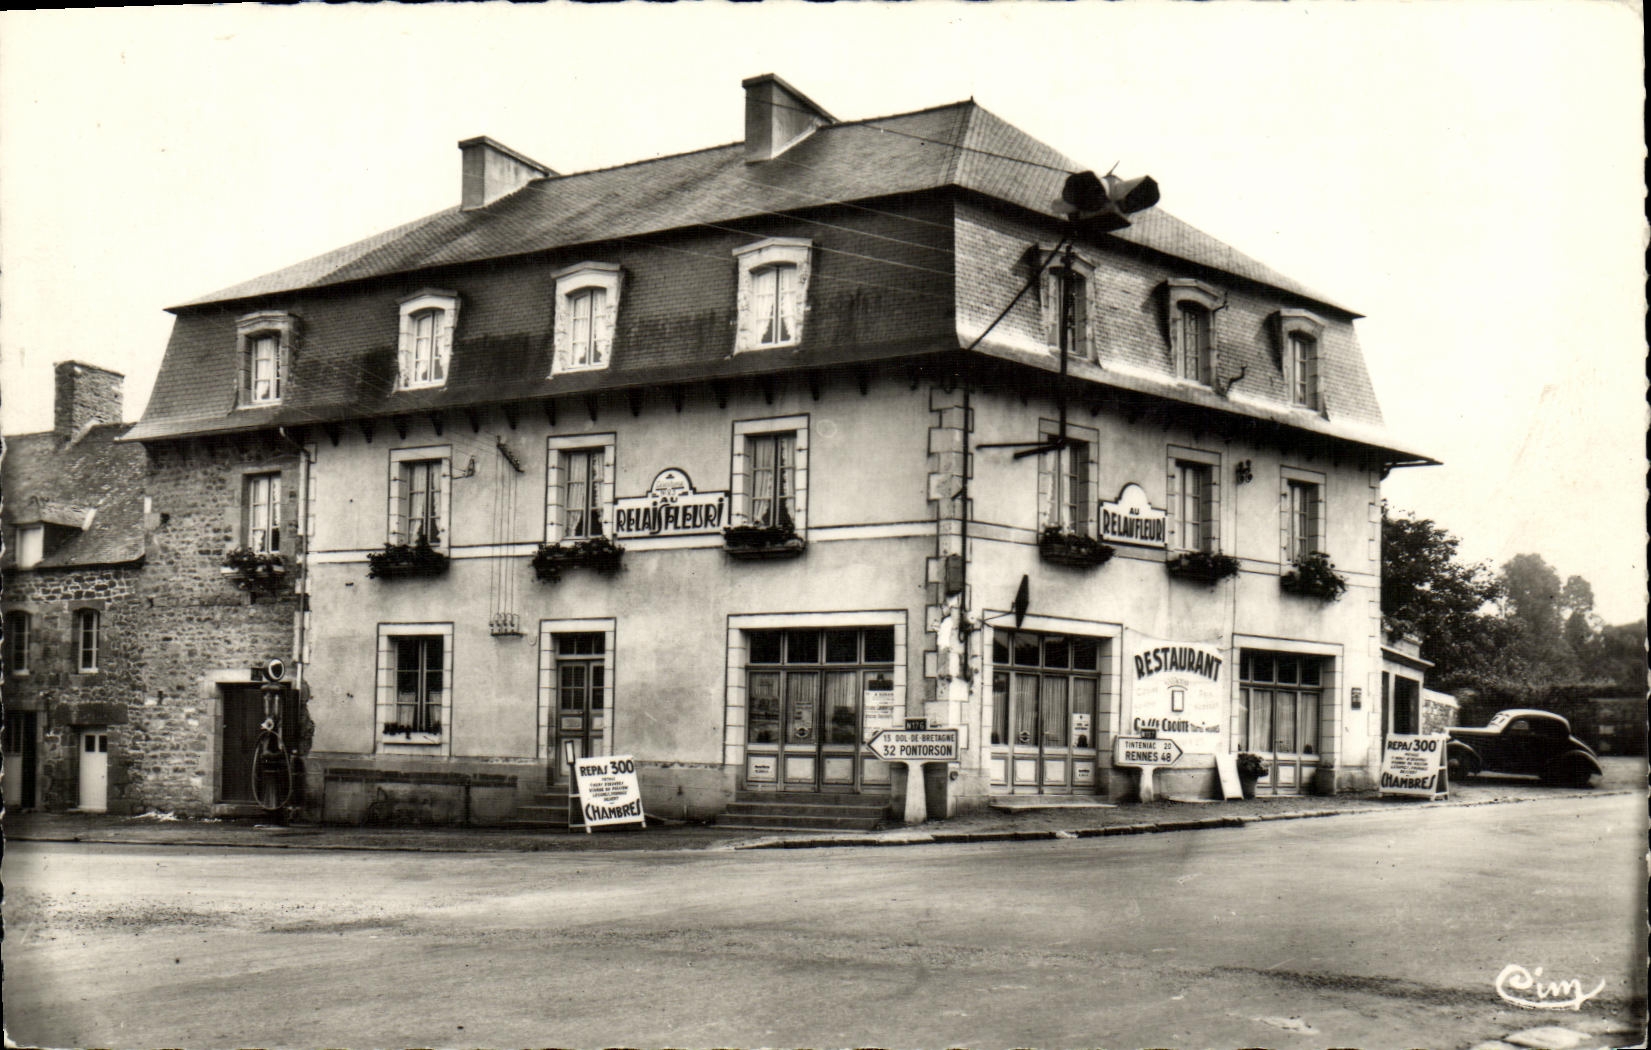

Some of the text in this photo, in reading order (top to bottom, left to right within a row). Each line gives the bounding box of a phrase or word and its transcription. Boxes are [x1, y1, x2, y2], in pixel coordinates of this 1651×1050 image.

[660, 496, 678, 504] AU
[1129, 507, 1140, 515] AU
[1134, 647, 1222, 682] RESTAURANT
[883, 745, 953, 756] 32 PONTORSON
[1125, 741, 1172, 750] TINTENIAC 20
[1387, 739, 1437, 753] REPAS 300
[1125, 751, 1172, 762] RENNES 48
[579, 759, 635, 777] REPAS 300
[1381, 771, 1437, 790] CHAMBRES
[584, 798, 642, 821] CHAMBRES
